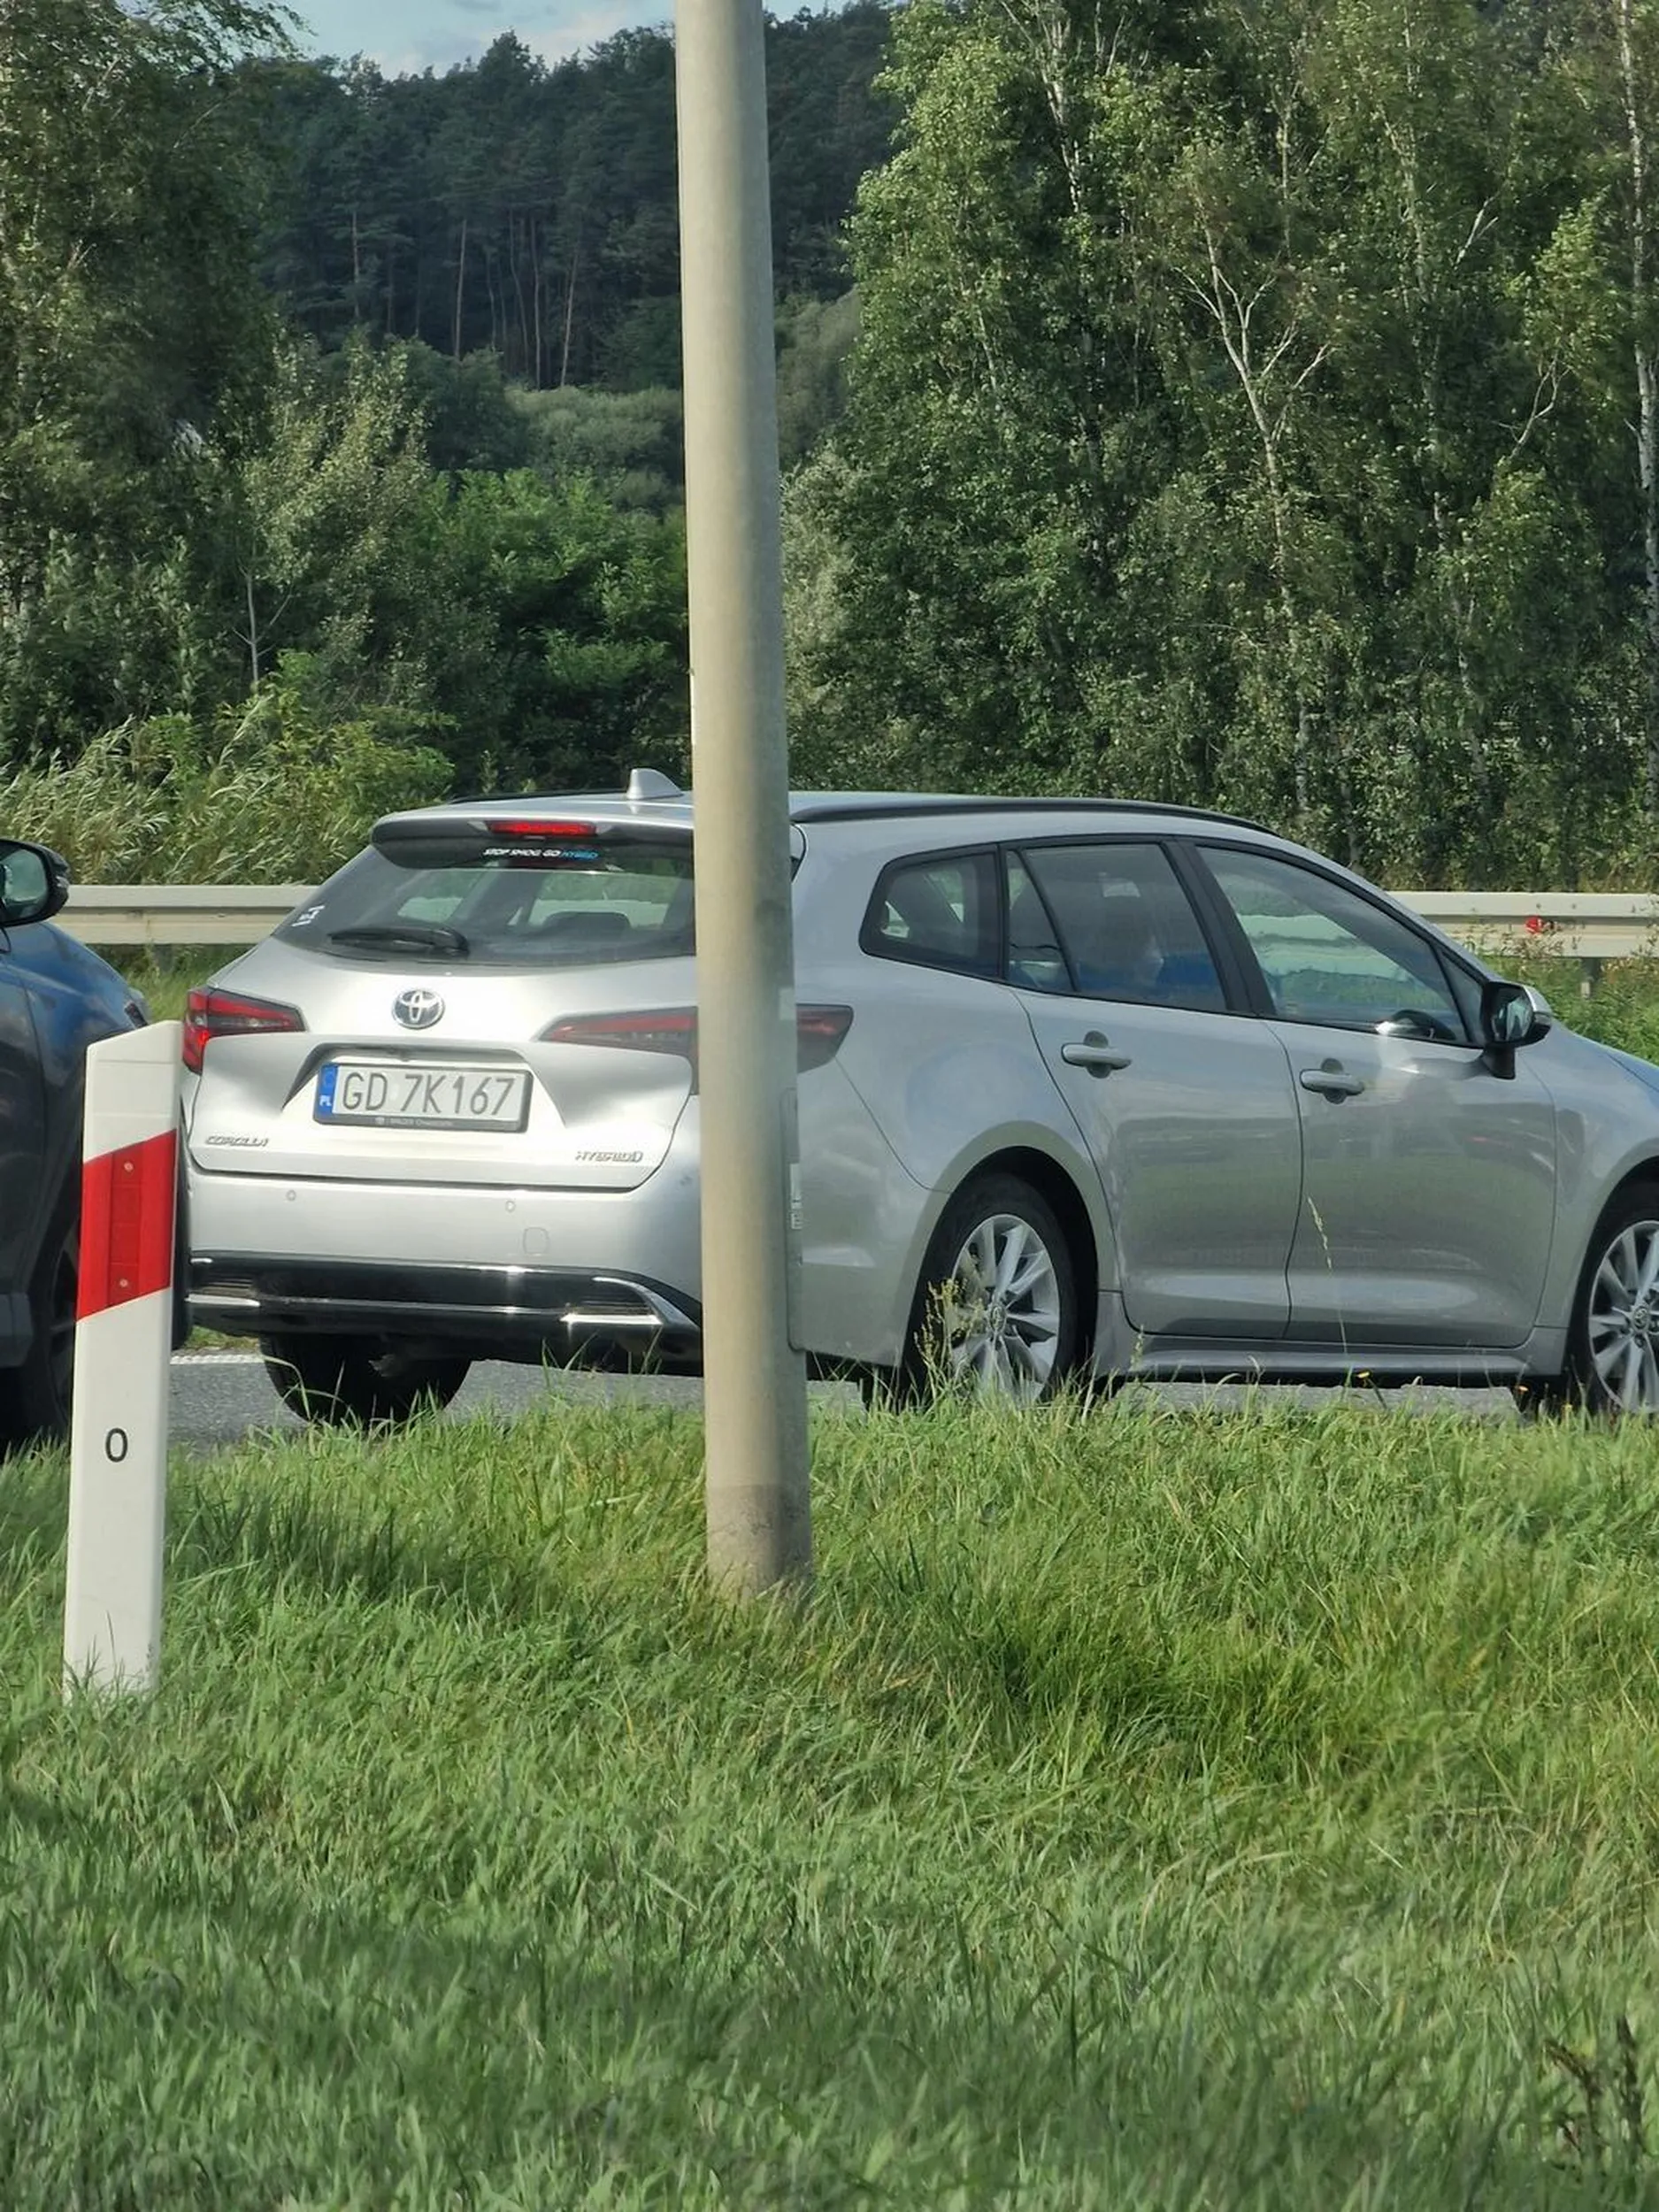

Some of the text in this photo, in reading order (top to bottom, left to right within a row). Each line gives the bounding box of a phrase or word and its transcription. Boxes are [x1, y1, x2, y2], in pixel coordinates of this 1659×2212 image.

[319, 1094, 332, 1107] PL
[342, 1072, 515, 1115] GD 7K167
